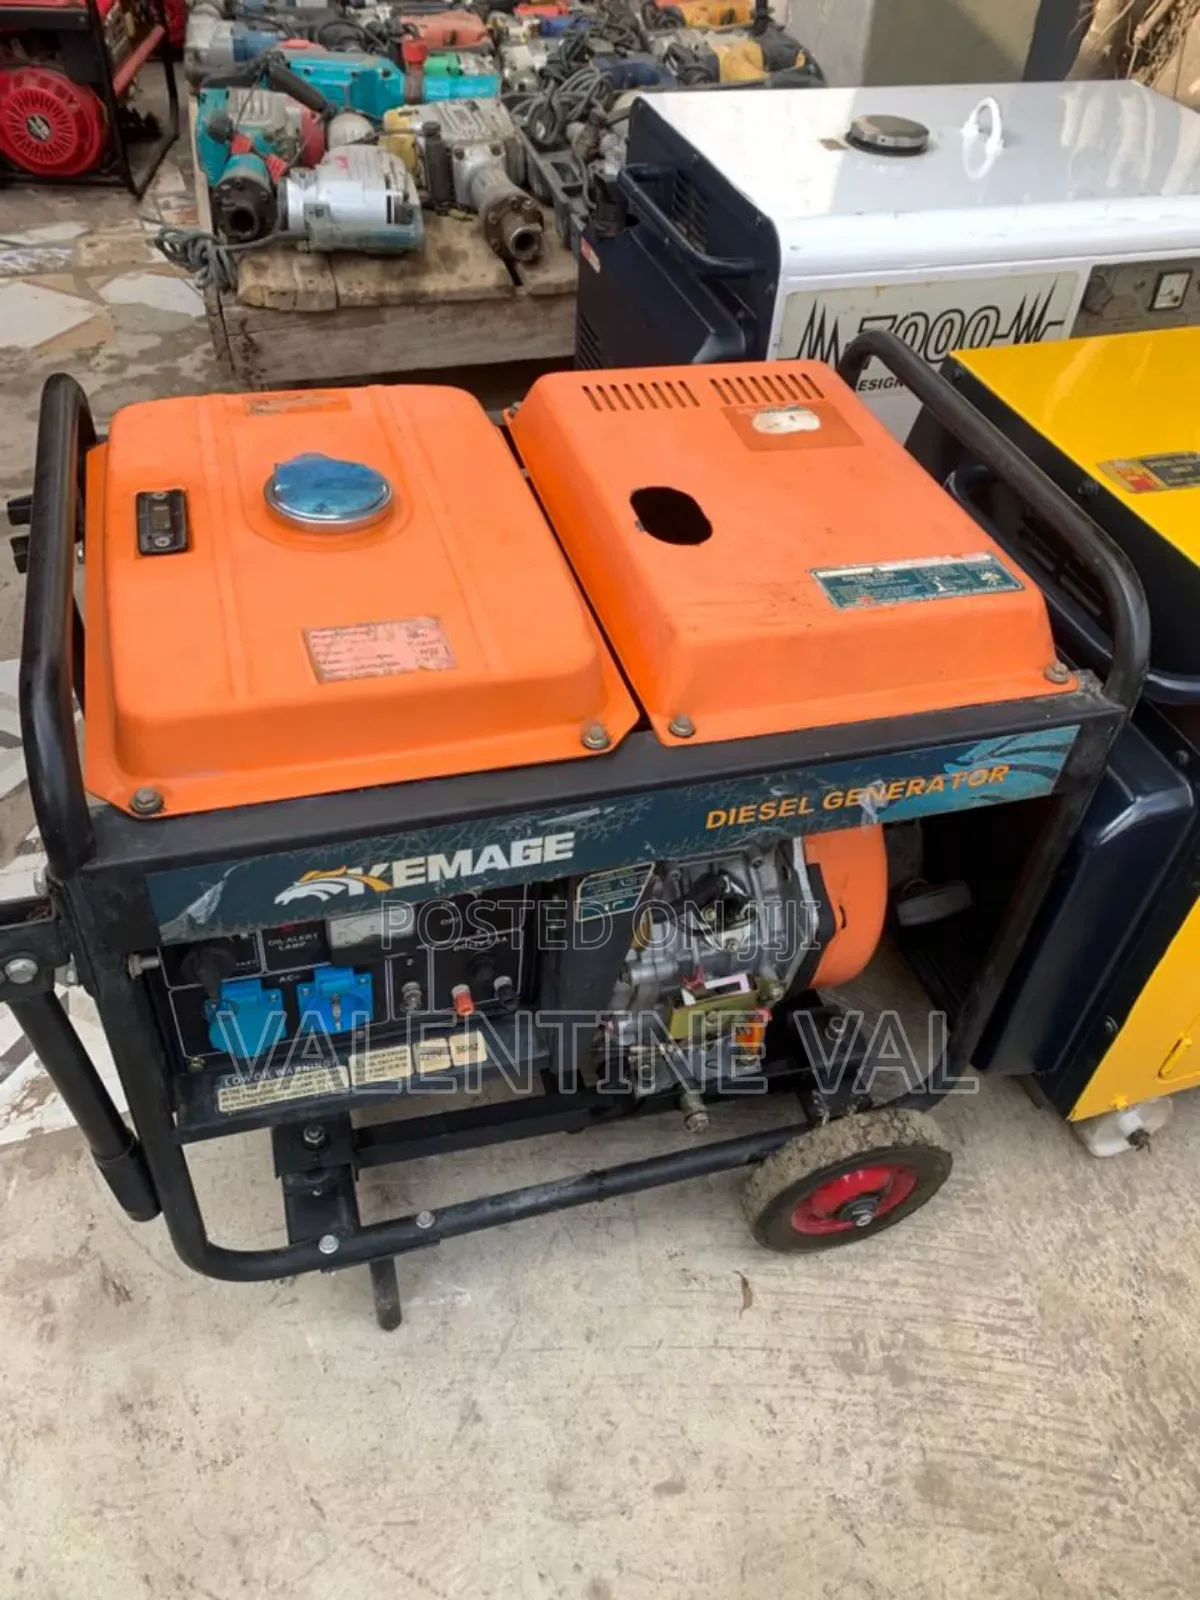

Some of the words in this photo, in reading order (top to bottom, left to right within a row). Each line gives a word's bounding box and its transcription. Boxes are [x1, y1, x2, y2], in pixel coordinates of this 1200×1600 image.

[705, 796, 817, 830] DIESEL
[822, 764, 1011, 811] GENERATOR
[345, 831, 577, 899] KEMAGE
[224, 1073, 250, 1088] LOW
